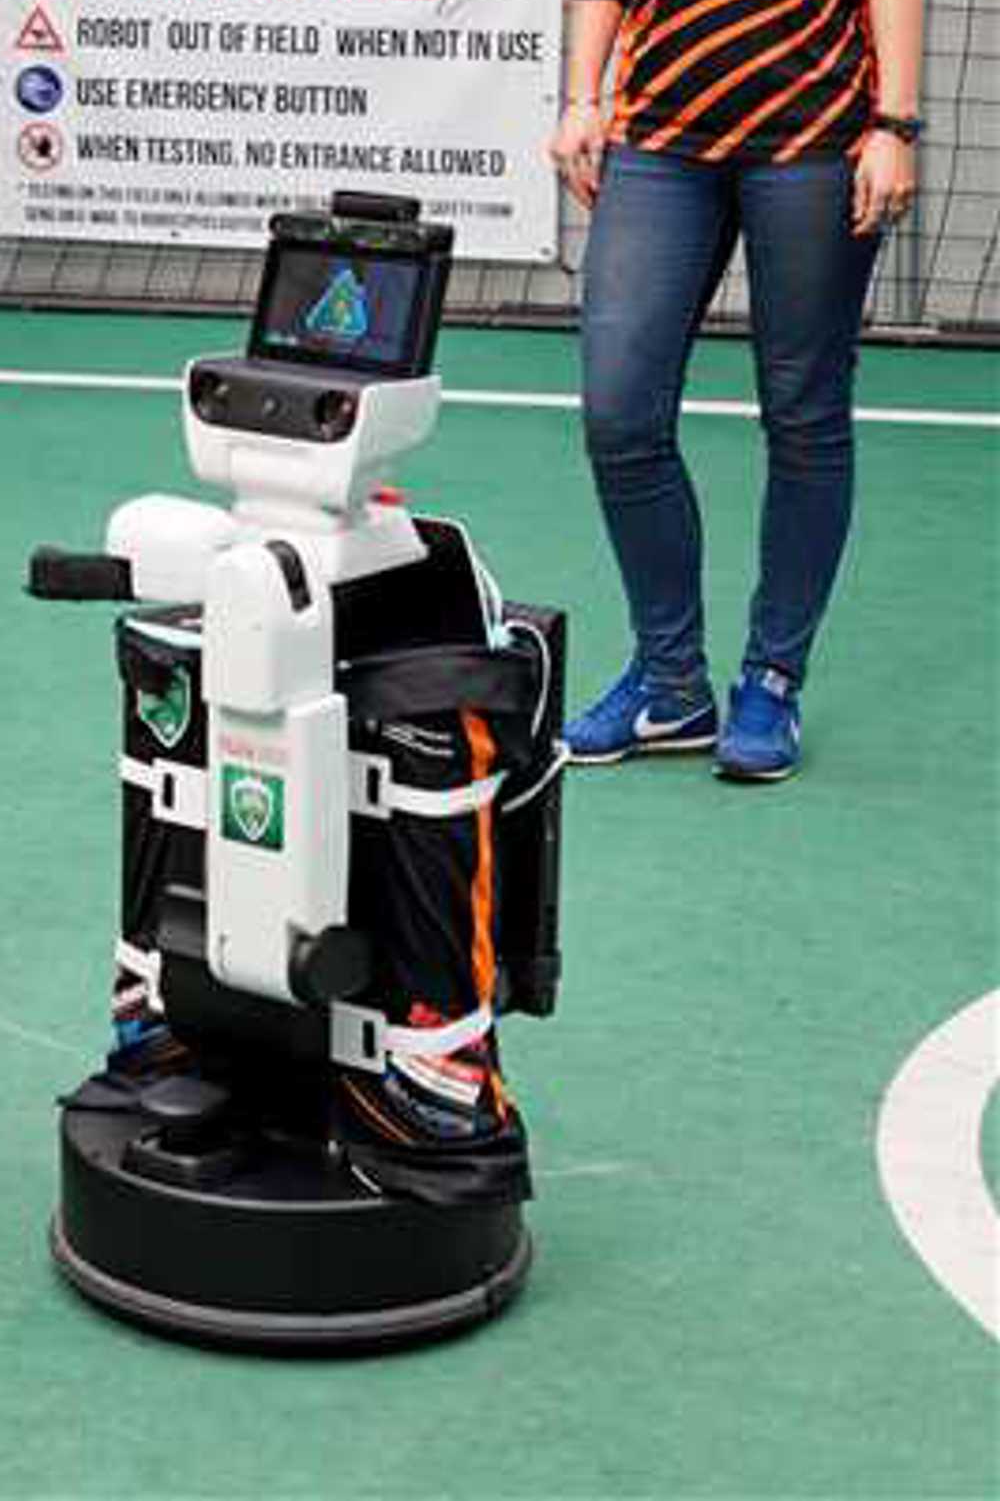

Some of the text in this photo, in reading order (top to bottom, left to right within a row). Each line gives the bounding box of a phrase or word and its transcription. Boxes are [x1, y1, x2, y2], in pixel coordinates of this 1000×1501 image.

[76, 17, 152, 50] ROBOT
[219, 21, 250, 53] OF
[336, 27, 408, 59] WHEN
[413, 28, 462, 60] NOT
[466, 30, 492, 62] IN
[496, 30, 544, 63] USE
[76, 77, 368, 117] USE EMERGENCY BUTTON
[76, 133, 140, 162] WHEN
[245, 139, 276, 167] NO
[279, 140, 395, 173] ENTRANCE
[400, 146, 506, 177] ALLOWED
